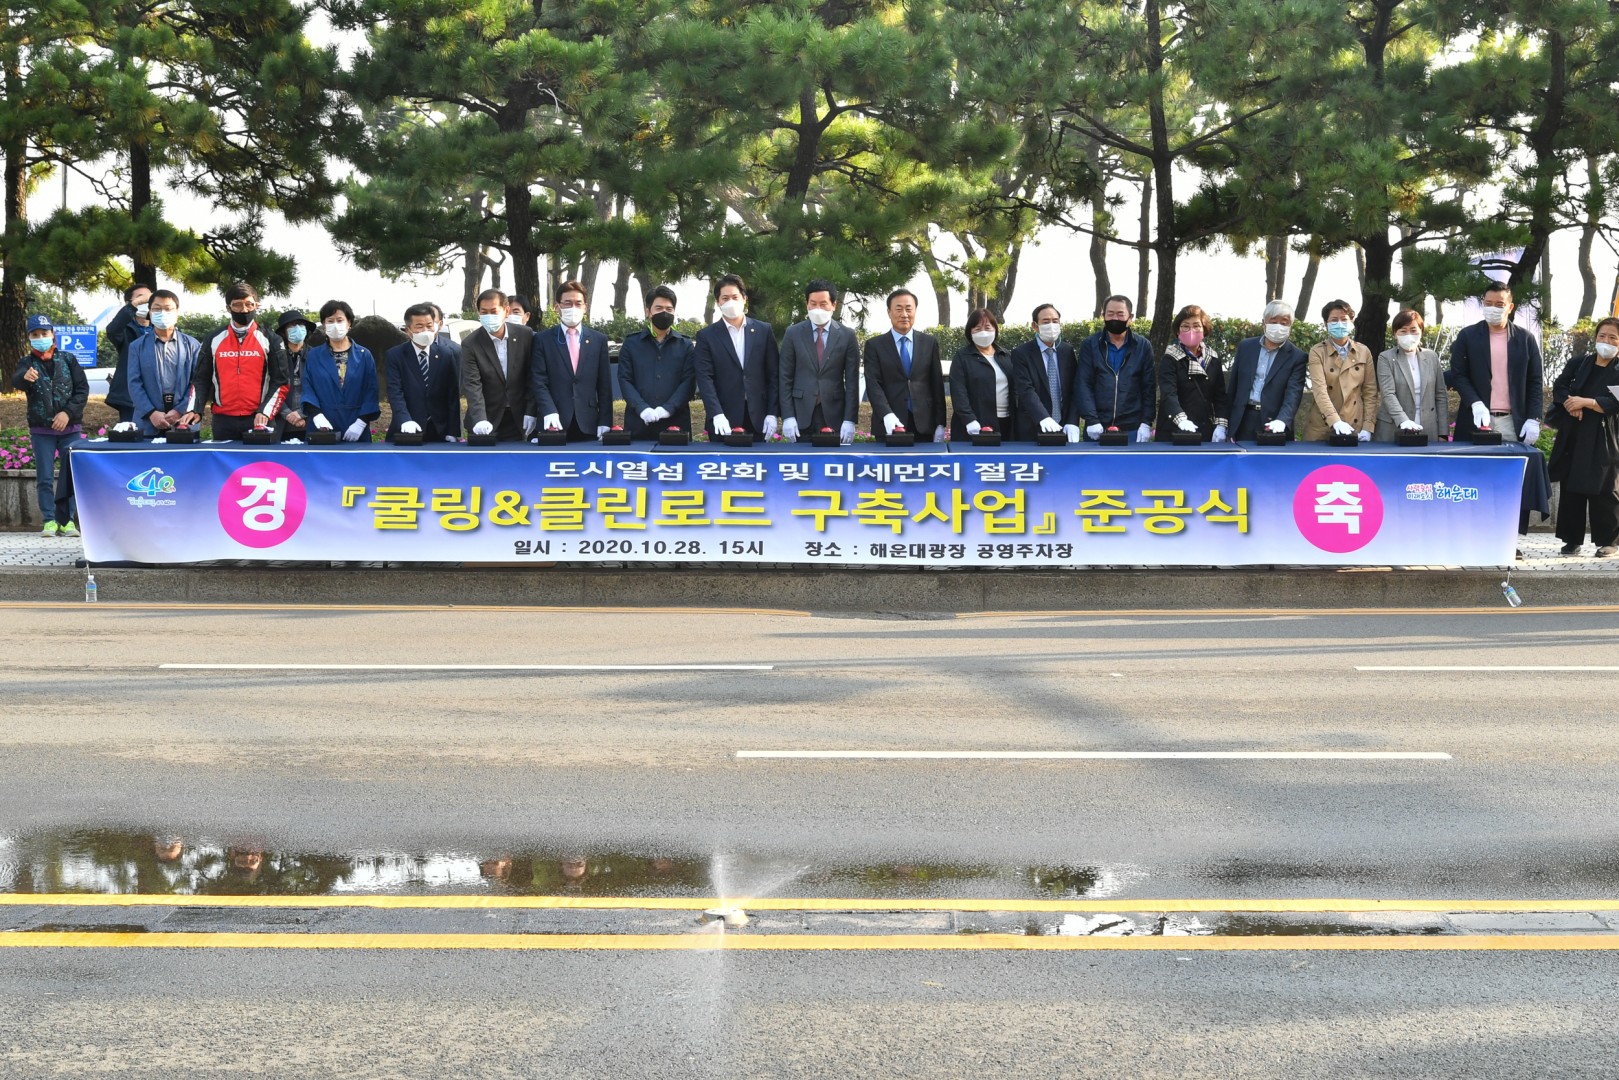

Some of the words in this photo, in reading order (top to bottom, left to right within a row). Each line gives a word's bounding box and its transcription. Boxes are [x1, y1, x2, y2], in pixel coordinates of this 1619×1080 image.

[61, 335, 72, 350] P
[219, 350, 261, 358] HONDA
[545, 460, 683, 481] 도시열섬
[696, 462, 767, 481] 완화
[778, 462, 810, 481] 및
[824, 462, 961, 482] 미세먼지
[974, 462, 1044, 482] 절감
[1436, 485, 1478, 501] 해운대
[235, 477, 288, 531] 경
[1074, 487, 1249, 534] 준공식
[1314, 481, 1363, 534] 축
[514, 540, 550, 555] 일시
[578, 540, 706, 555] 2020.10.28.
[719, 540, 764, 556] 15시
[804, 541, 842, 557] 장소
[869, 543, 966, 559] 해운대광장
[976, 543, 1074, 559] 공영주차장
